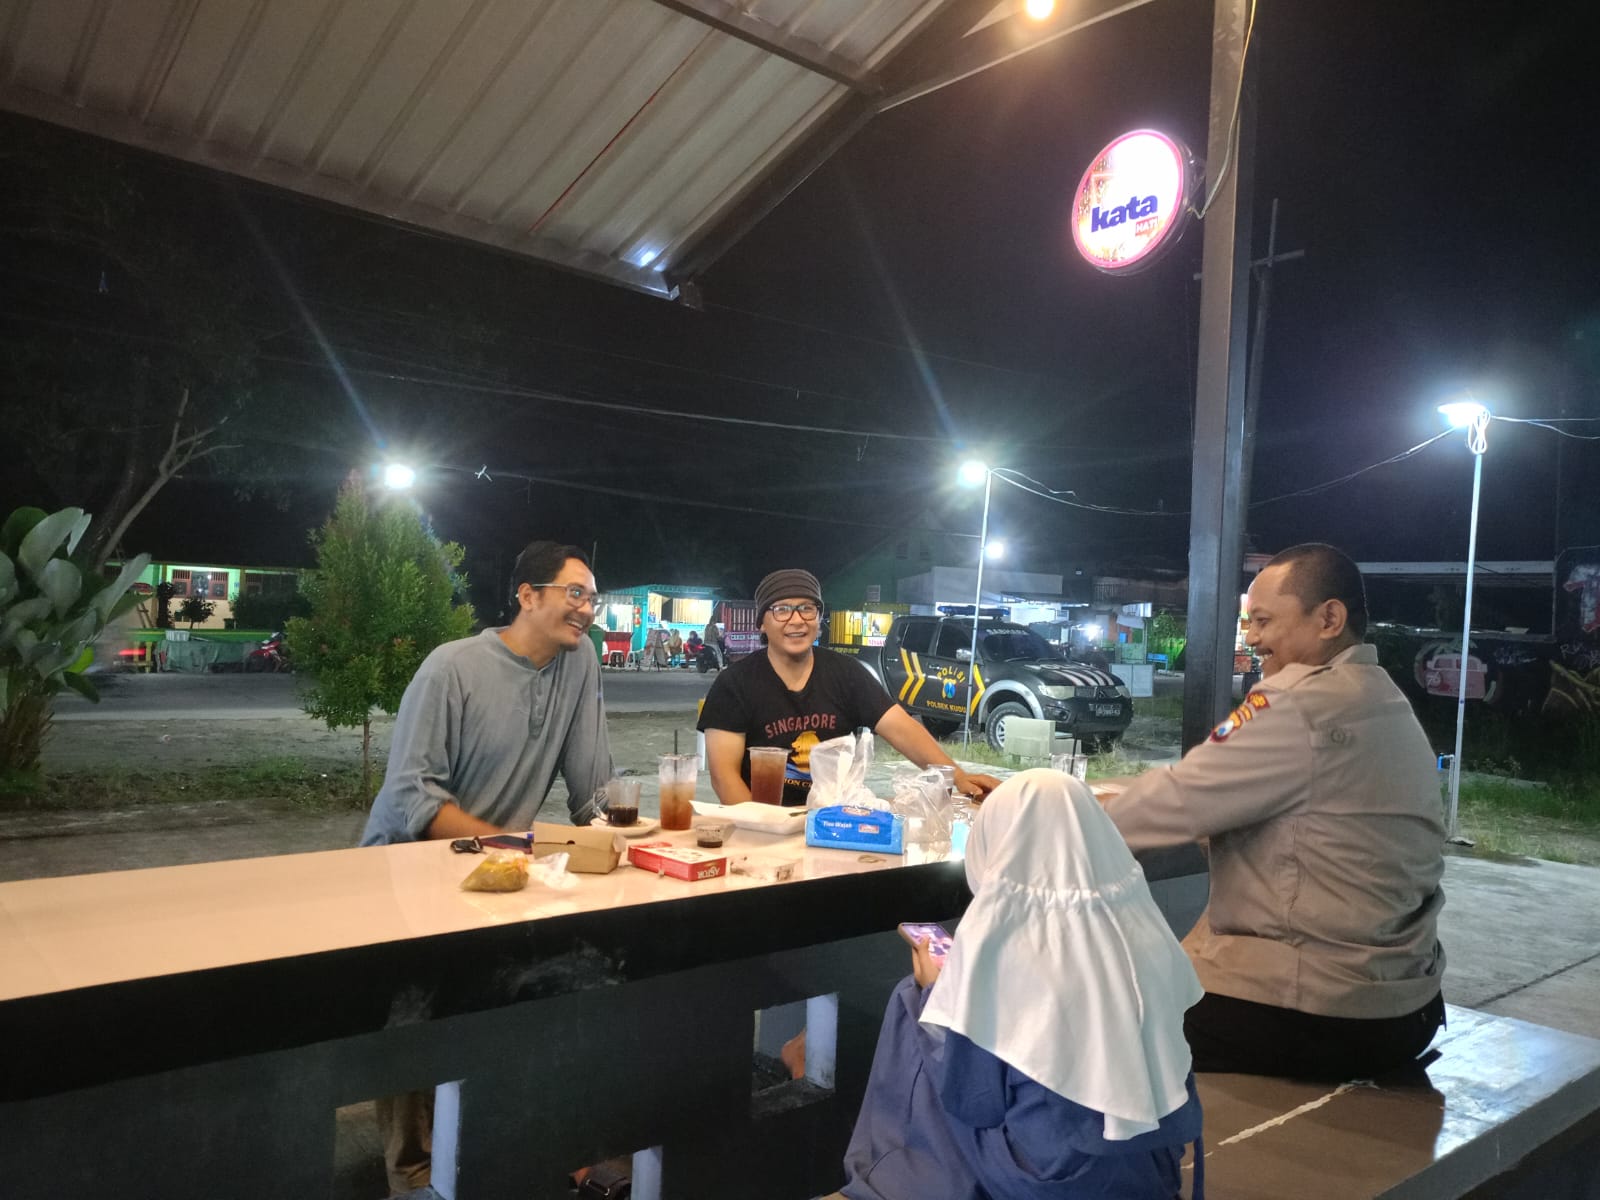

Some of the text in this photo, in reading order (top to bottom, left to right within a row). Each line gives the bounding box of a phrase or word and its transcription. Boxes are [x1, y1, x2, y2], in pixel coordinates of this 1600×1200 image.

[1081, 195, 1158, 233] kata
[937, 666, 966, 683] POLISI
[926, 700, 949, 711] POLSEK
[765, 713, 837, 739] SINGAPORE
